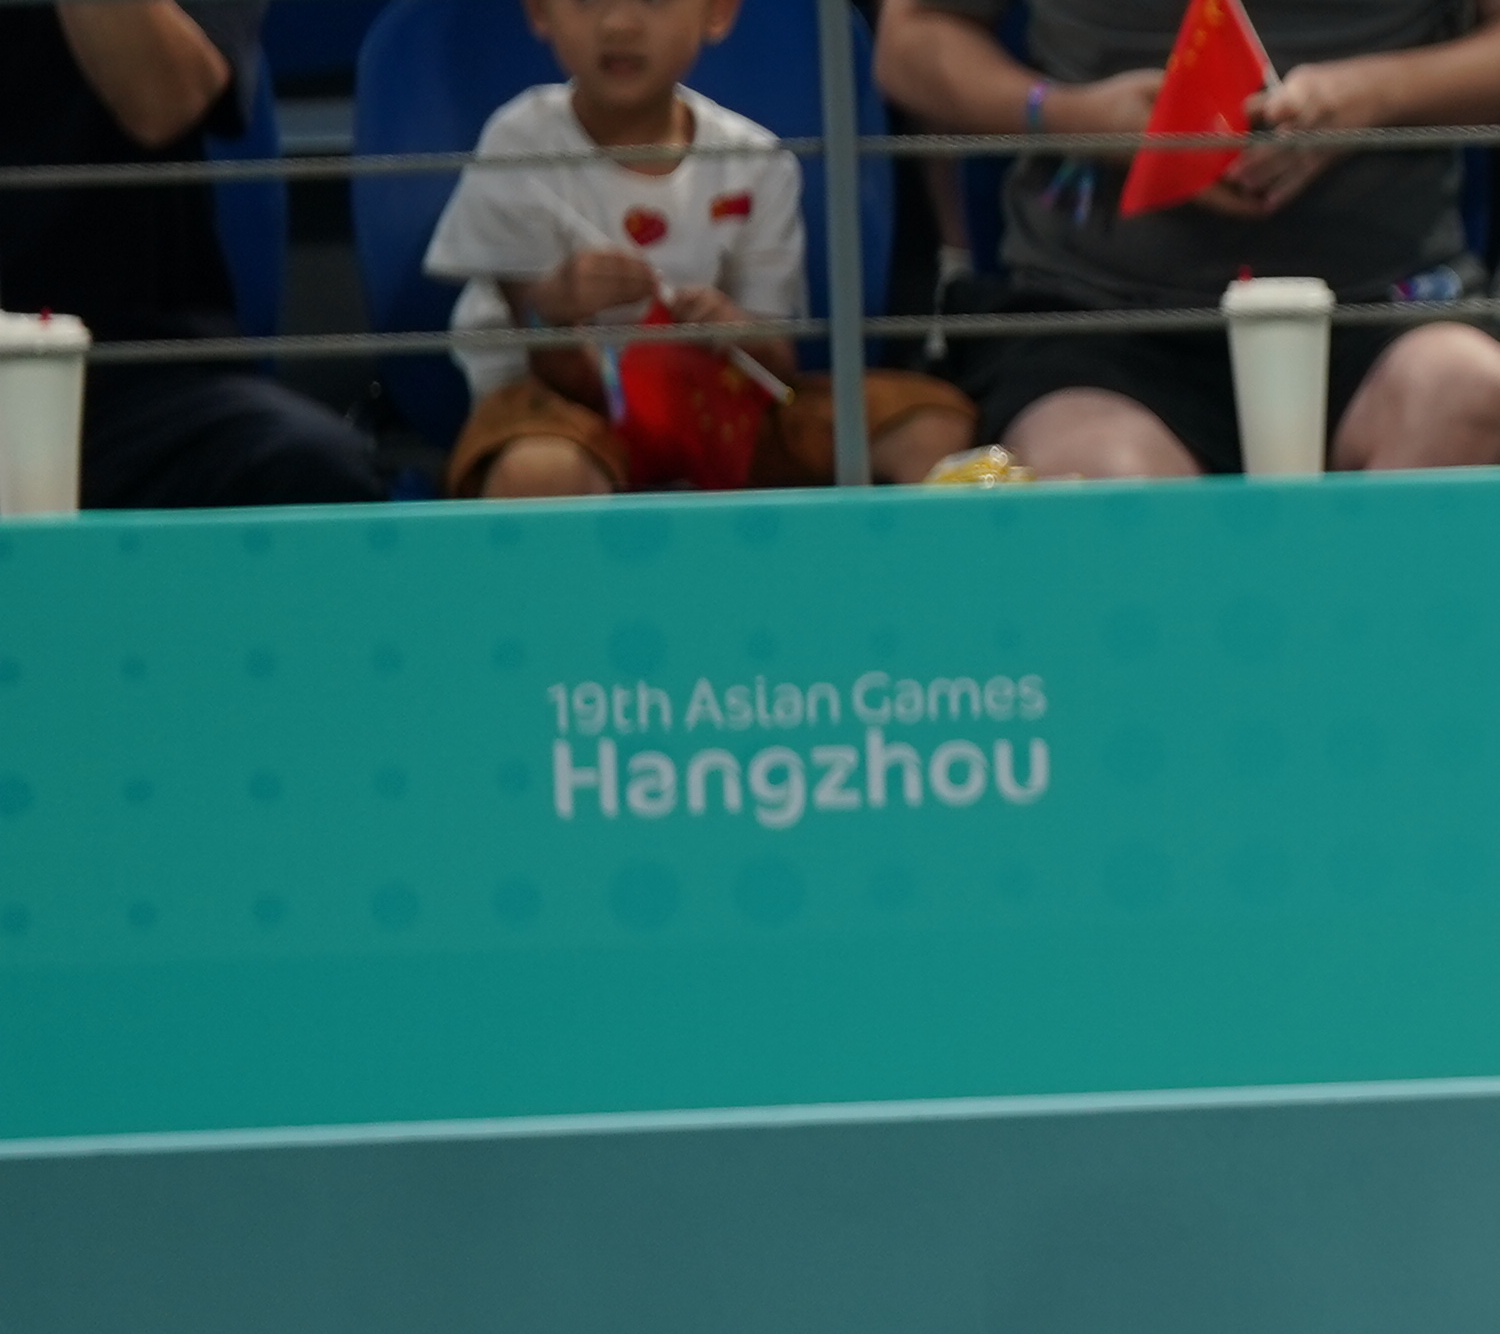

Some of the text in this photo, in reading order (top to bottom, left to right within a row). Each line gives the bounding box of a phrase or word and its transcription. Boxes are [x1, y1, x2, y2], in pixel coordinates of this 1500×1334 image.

[547, 669, 1049, 735] 19th Asian Games
[552, 725, 1051, 829] Hangzhou
